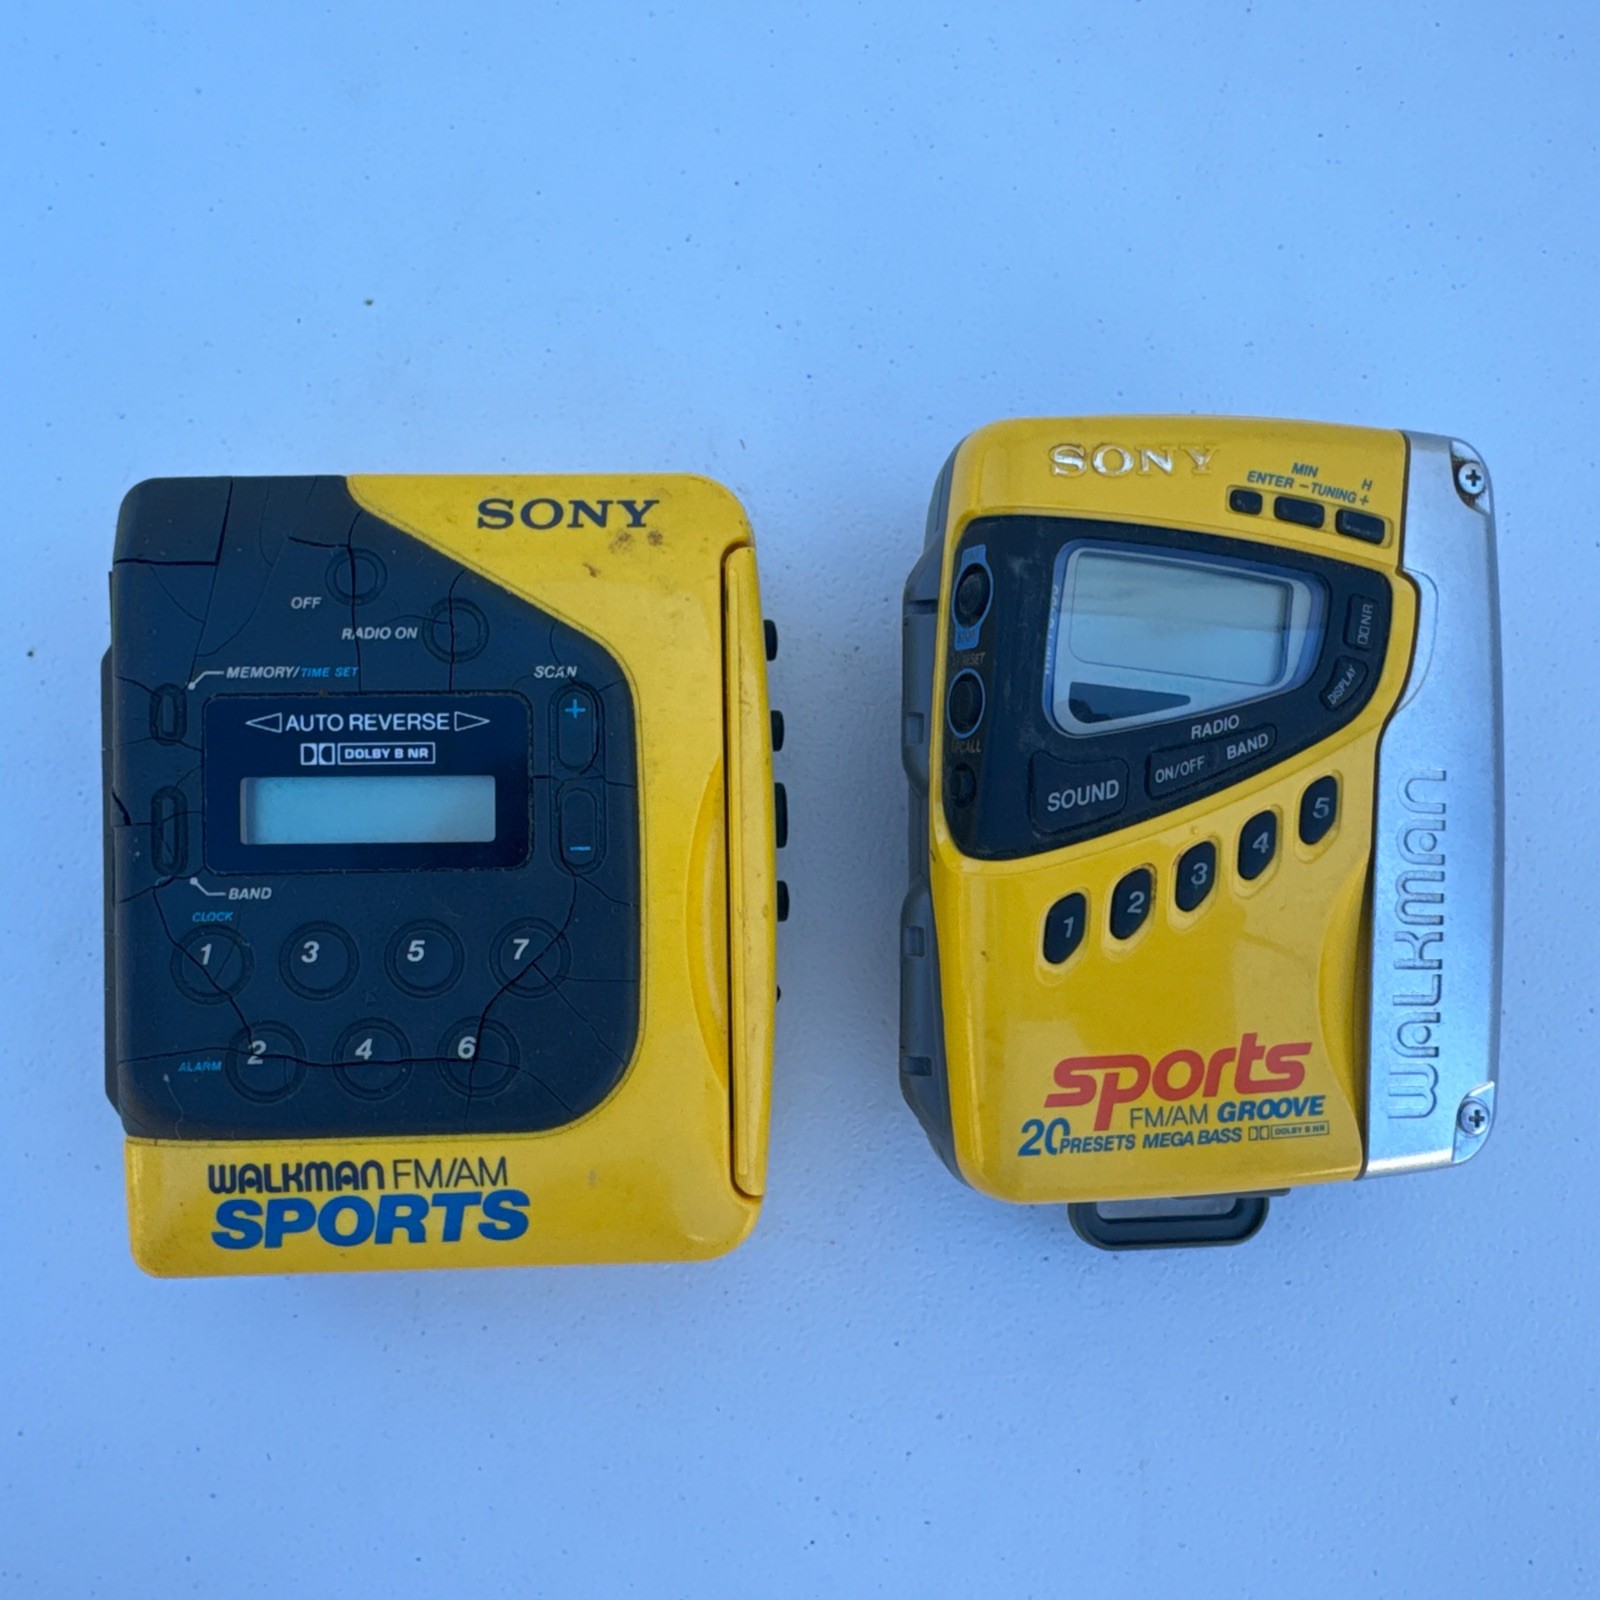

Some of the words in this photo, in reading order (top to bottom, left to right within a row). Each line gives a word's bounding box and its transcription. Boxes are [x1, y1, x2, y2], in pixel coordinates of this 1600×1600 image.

[1049, 442, 1220, 478] SONY
[1291, 462, 1319, 479] MIN
[1246, 470, 1295, 489] ENTER
[1360, 478, 1374, 492] H
[477, 497, 660, 530] SONY
[290, 596, 322, 610] OFF
[341, 626, 392, 640] RADIO
[394, 626, 418, 639] ON
[334, 666, 359, 678] SET
[533, 665, 577, 679] SCAN
[1326, 663, 1357, 706] DISPLAY
[285, 713, 344, 732] AUTO
[349, 712, 450, 732] REVERSE
[1190, 714, 1240, 740] RADIO
[343, 748, 391, 760] DOLBY
[394, 747, 404, 759] B
[407, 747, 429, 759] NR
[1226, 732, 1269, 760] BAND
[1155, 755, 1206, 784] ON/OFF
[1046, 779, 1120, 812] SOUND
[1312, 797, 1330, 820] 5
[1252, 831, 1269, 854] 4
[1190, 862, 1208, 886] 3
[228, 886, 273, 901] BAND
[1126, 890, 1145, 914] 2
[192, 911, 234, 923] CLOCK
[1062, 916, 1075, 938] 1
[199, 943, 212, 966] 1
[301, 940, 320, 963] 3
[406, 939, 425, 962] 5
[512, 938, 530, 960] 7
[1388, 768, 1446, 1119] WALKMAN
[247, 1039, 268, 1065] 2
[354, 1037, 373, 1060] 4
[457, 1036, 478, 1060] 6
[177, 1061, 222, 1073] ALARM
[1129, 1103, 1209, 1130] FM/AM
[1217, 1094, 1327, 1124] GROOVE
[1018, 1117, 1071, 1157] 20
[1059, 1132, 1136, 1155] PRESETS
[1142, 1129, 1195, 1149] MEGA
[1197, 1126, 1242, 1146] BASS
[208, 1159, 386, 1194] WALKMAN
[392, 1155, 509, 1190] FM/AM
[211, 1188, 531, 1251] SPORTS
